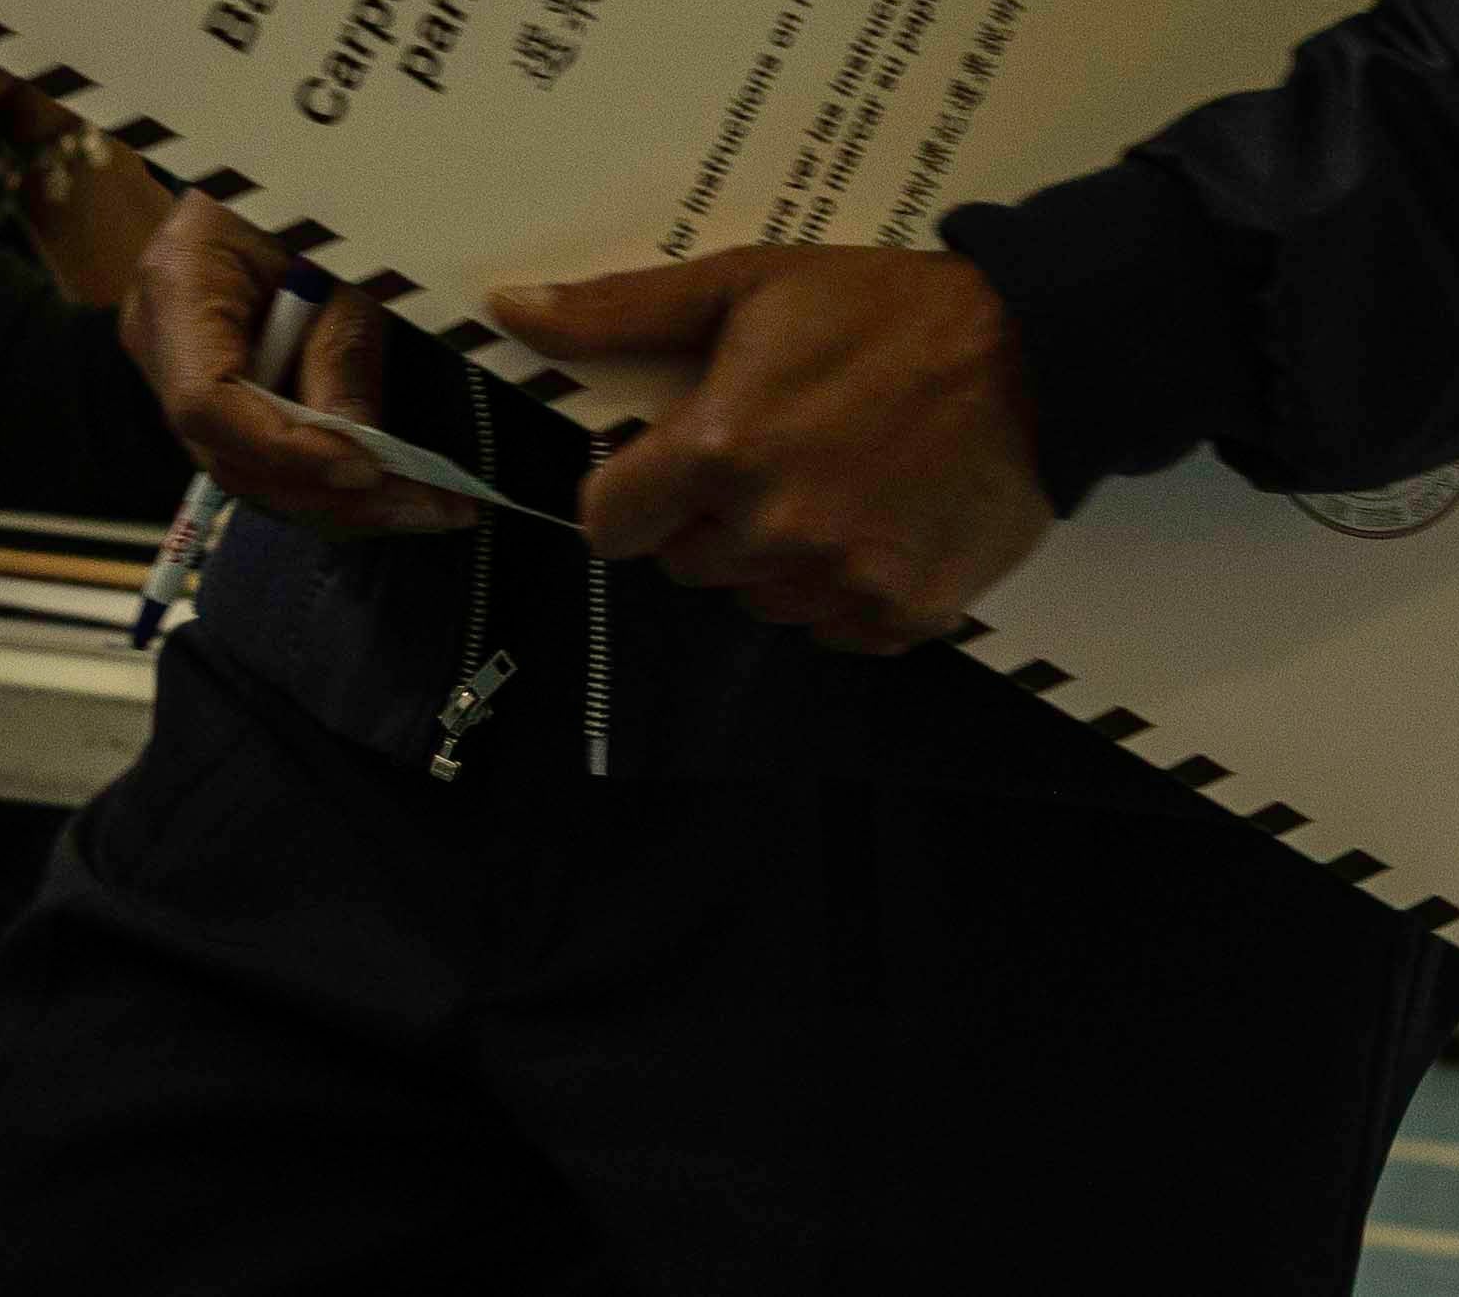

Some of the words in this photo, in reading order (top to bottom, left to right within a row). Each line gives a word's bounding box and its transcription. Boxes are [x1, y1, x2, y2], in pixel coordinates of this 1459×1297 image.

[679, 53, 783, 216] instructions
[769, 11, 804, 50] on
[783, 147, 823, 191] ver
[804, 102, 846, 145] las
[822, 94, 886, 193] marcar
[873, 55, 908, 92] su
